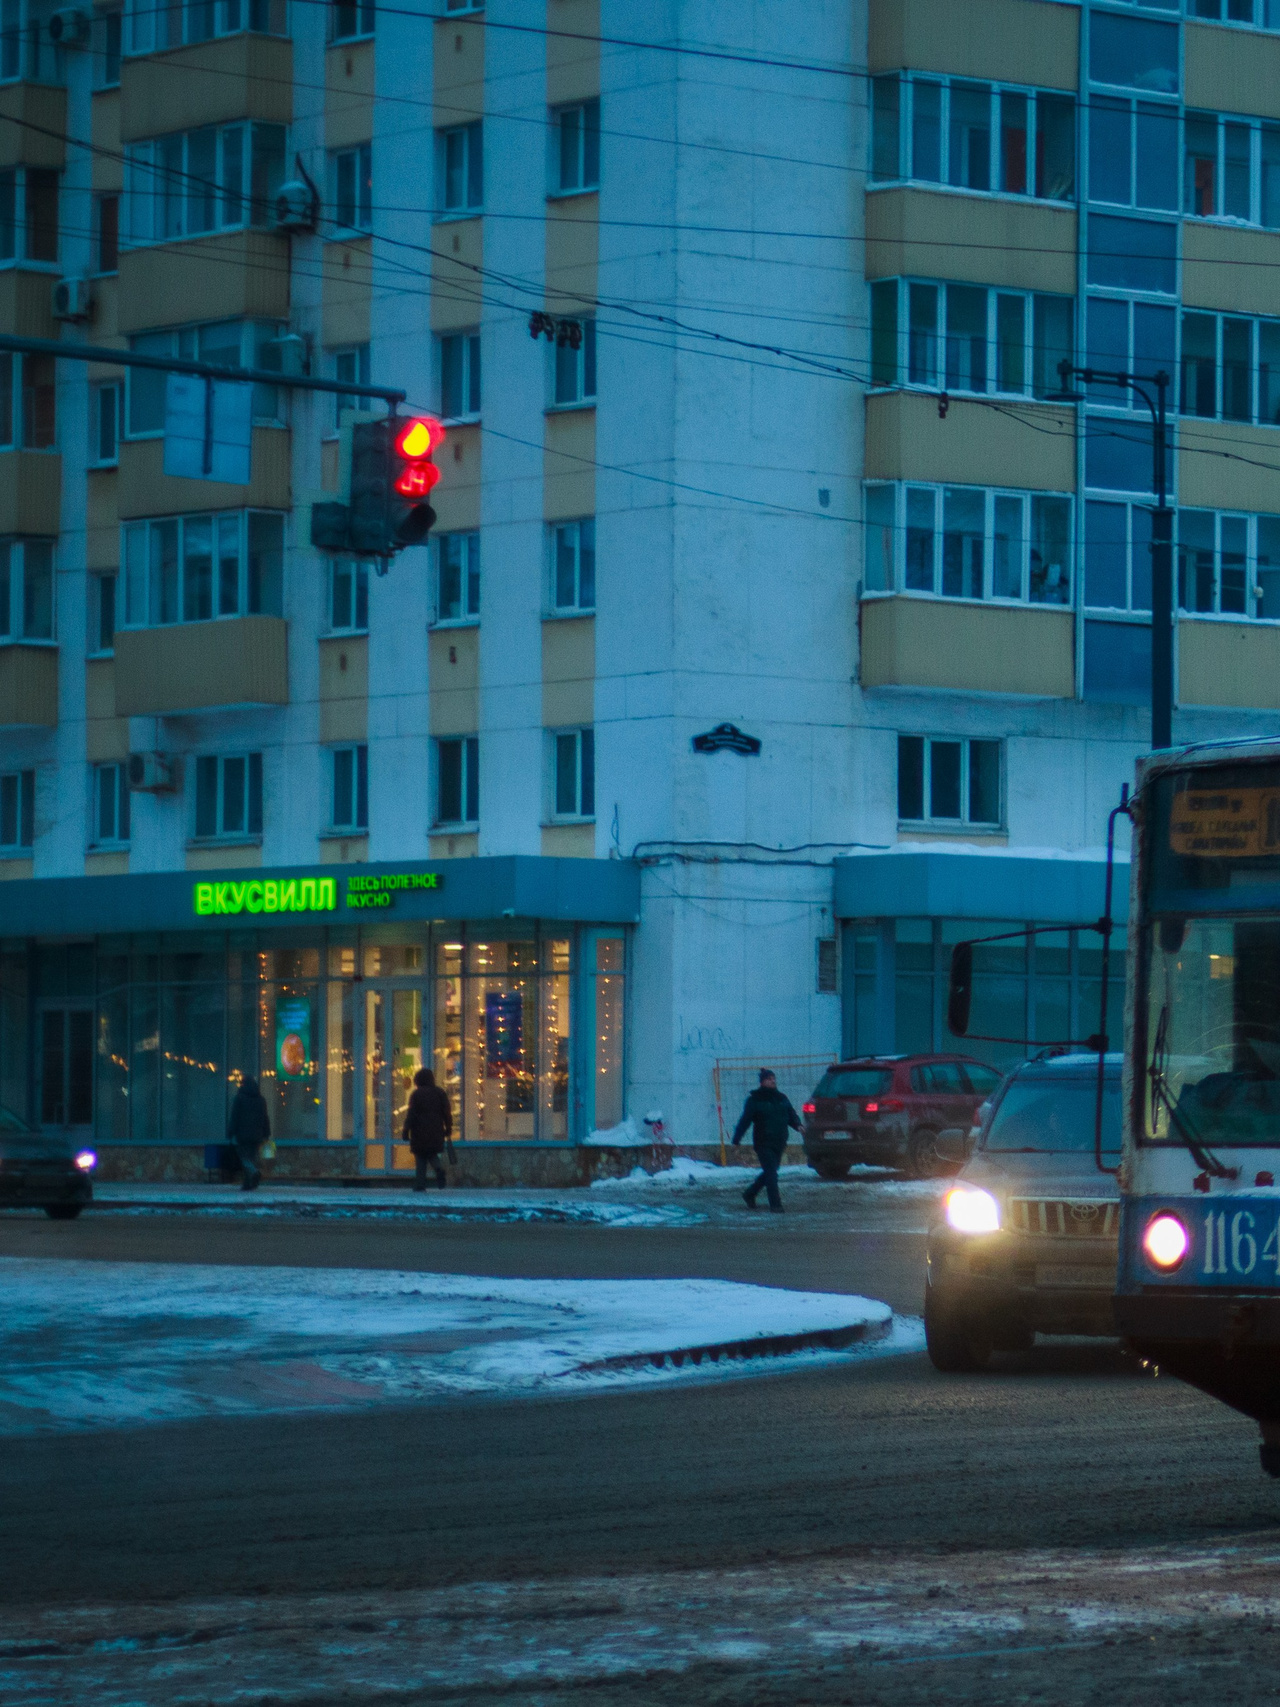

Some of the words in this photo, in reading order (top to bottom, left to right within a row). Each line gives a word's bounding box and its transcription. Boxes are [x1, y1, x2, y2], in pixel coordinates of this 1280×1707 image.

[381, 873, 437, 889] ПОЛЕЗНОЕ
[195, 878, 337, 914] ВКУСВИЛЛ
[346, 892, 390, 908] ВКУСНО
